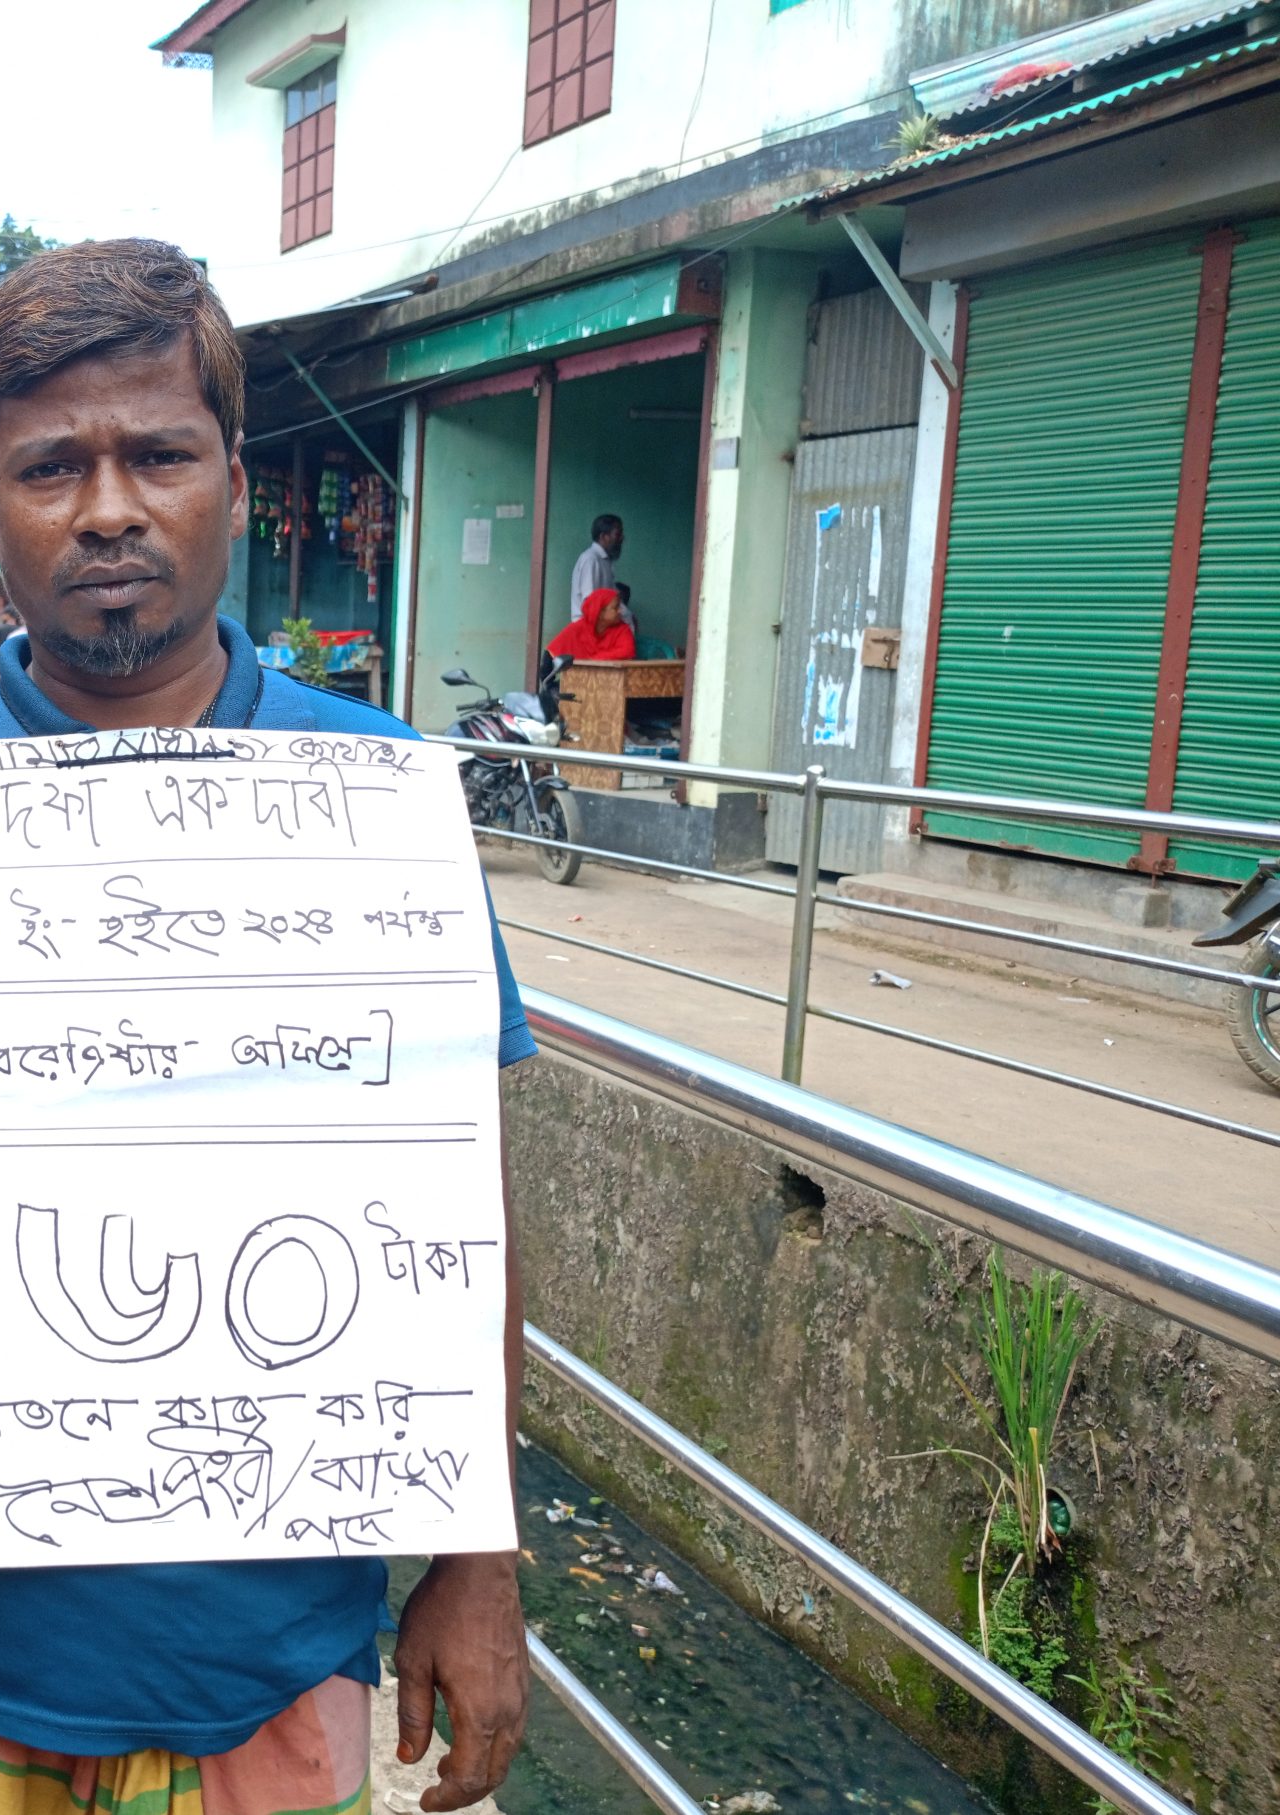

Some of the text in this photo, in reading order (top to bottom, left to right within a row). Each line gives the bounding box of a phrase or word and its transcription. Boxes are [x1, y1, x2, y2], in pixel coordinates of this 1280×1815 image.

[15, 1202, 361, 1371] ৬০
[363, 1200, 498, 1295] টাকা
[316, 1381, 474, 1442] করি
